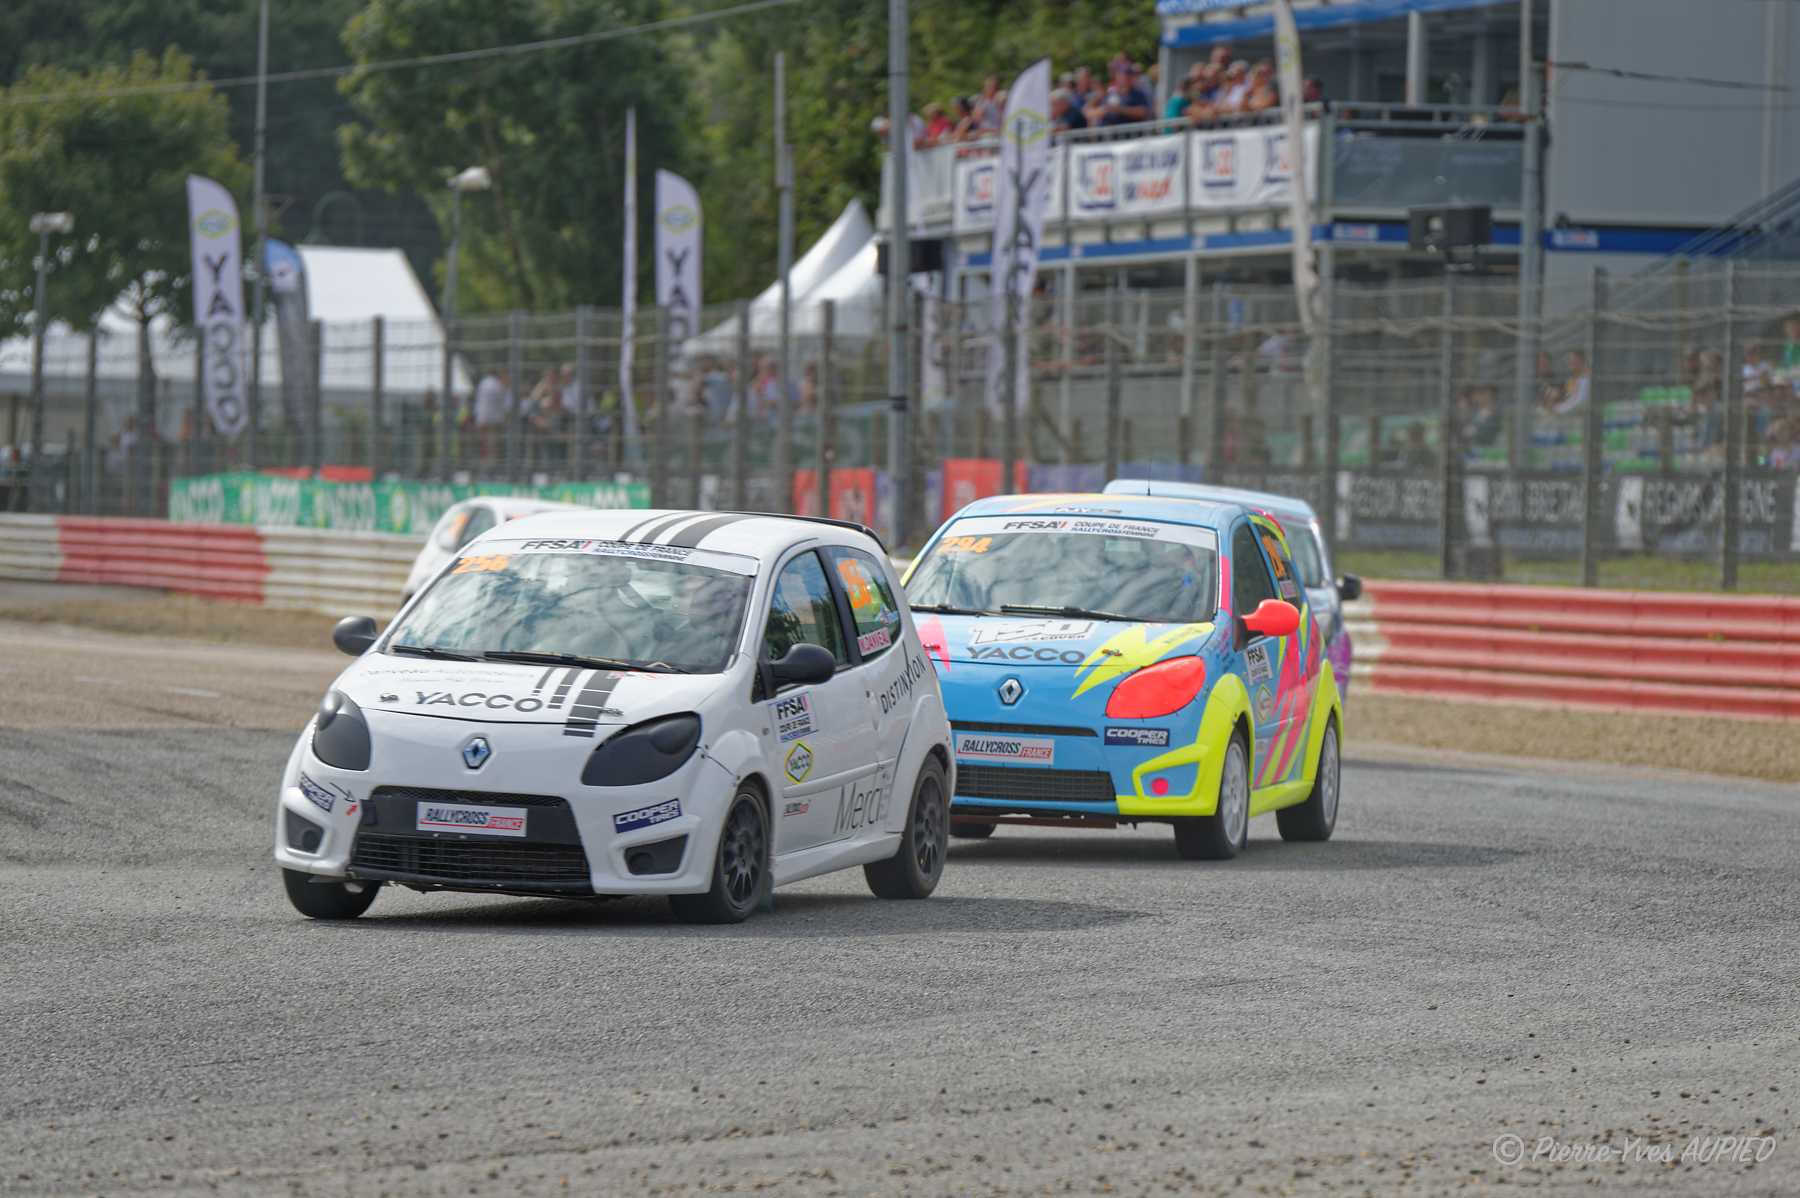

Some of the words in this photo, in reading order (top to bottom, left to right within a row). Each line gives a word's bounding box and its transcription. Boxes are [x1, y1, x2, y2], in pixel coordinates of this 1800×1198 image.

[1003, 520, 1060, 530] FFSA
[520, 539, 580, 550] FFSA
[939, 536, 993, 555] 294
[965, 645, 1085, 664] YACCO
[415, 690, 544, 713] YACCO
[776, 695, 806, 720] FFSA
[1106, 728, 1168, 739] COOPER
[961, 739, 1021, 755] RALLYCROSS
[1021, 748, 1052, 759] FRANCE
[425, 807, 489, 825] RALLYCROSS
[615, 800, 679, 825] COOPER
